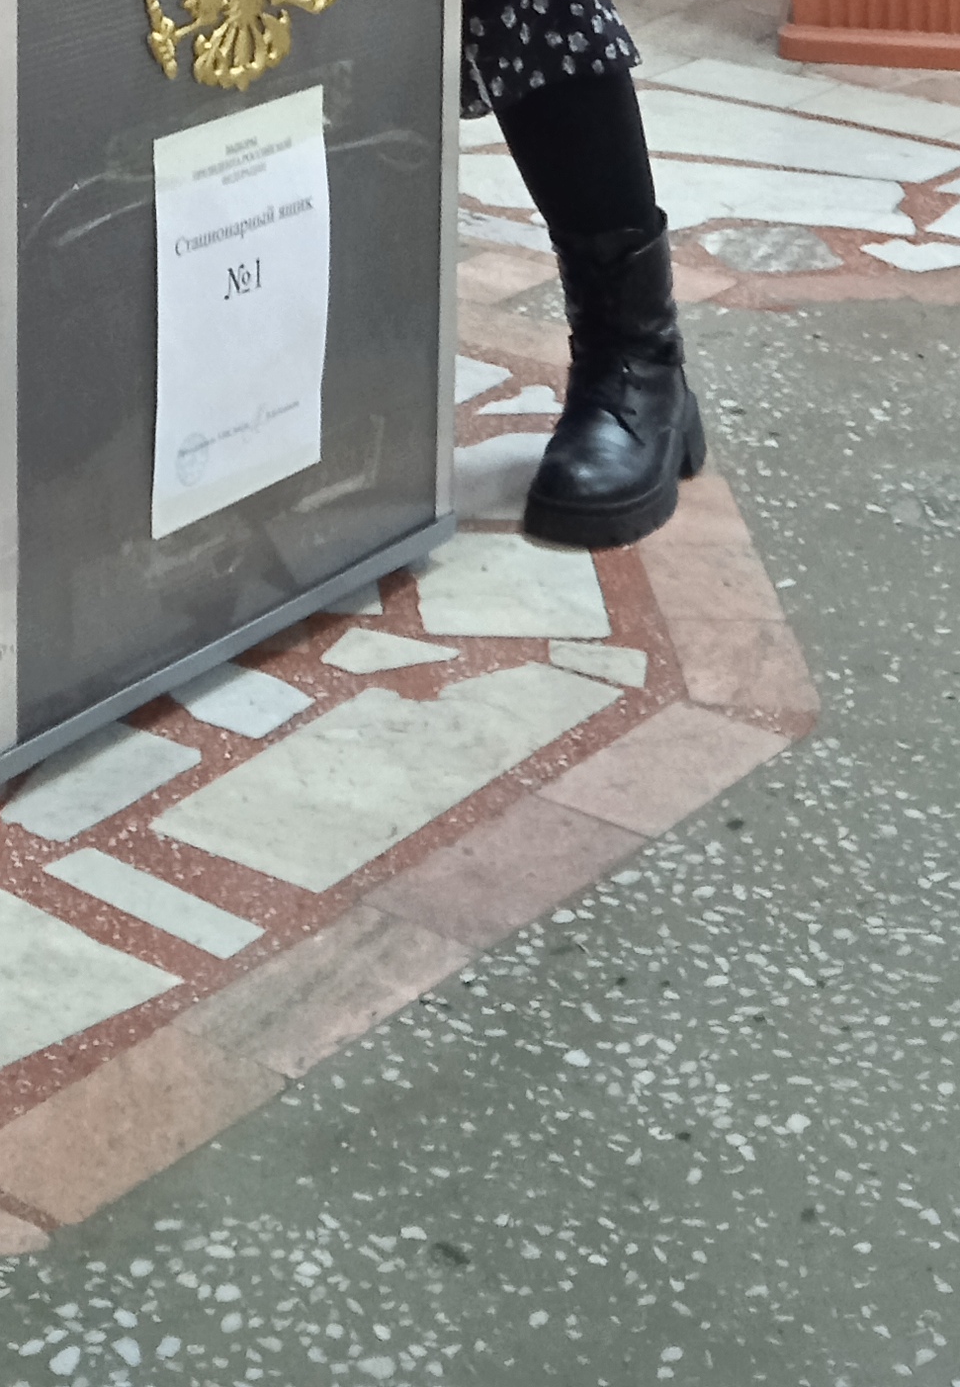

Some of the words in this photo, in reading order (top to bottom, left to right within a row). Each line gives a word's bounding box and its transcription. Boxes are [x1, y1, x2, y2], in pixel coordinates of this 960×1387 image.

[175, 206, 275, 257] Стационарный
[278, 196, 314, 220] ящик
[224, 257, 261, 300] №1
